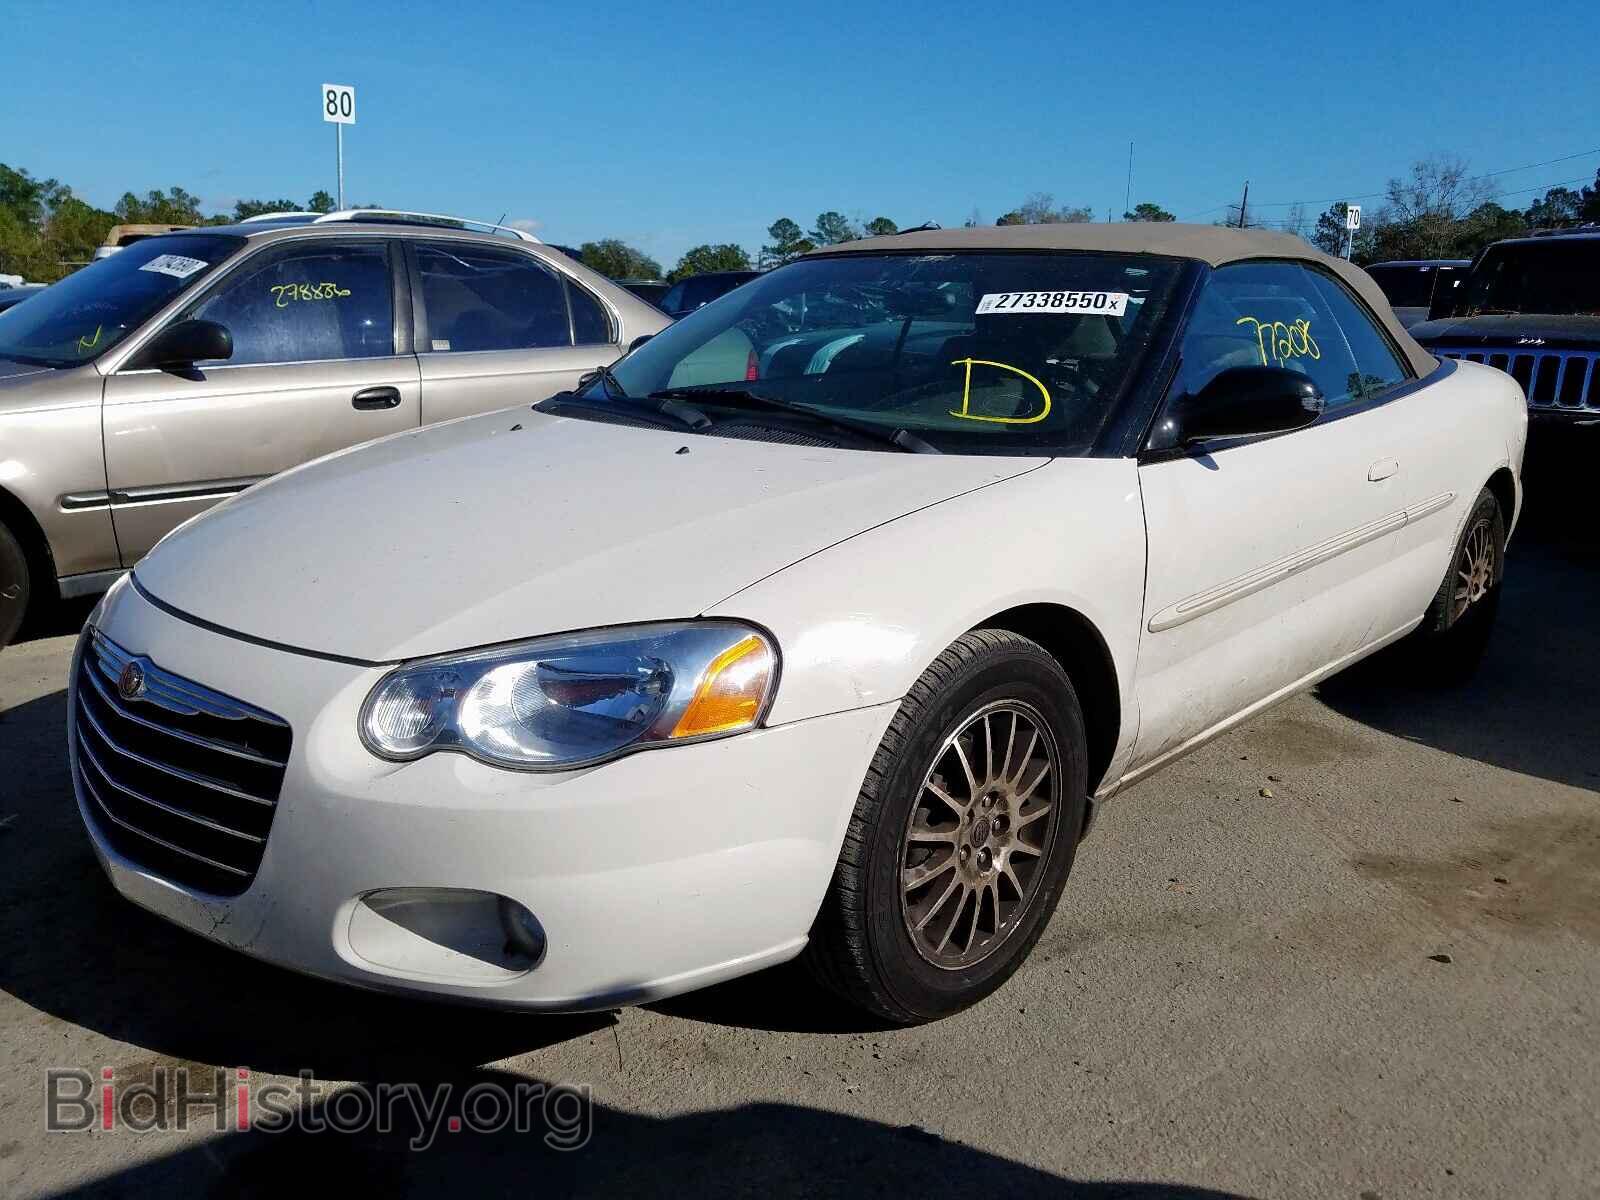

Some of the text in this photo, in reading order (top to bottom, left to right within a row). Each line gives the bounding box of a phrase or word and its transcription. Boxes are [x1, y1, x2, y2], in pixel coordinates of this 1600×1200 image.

[326, 89, 352, 117] 80
[1348, 209, 1360, 226] 70
[994, 292, 1108, 309] 27338550
[948, 357, 1052, 425] D
